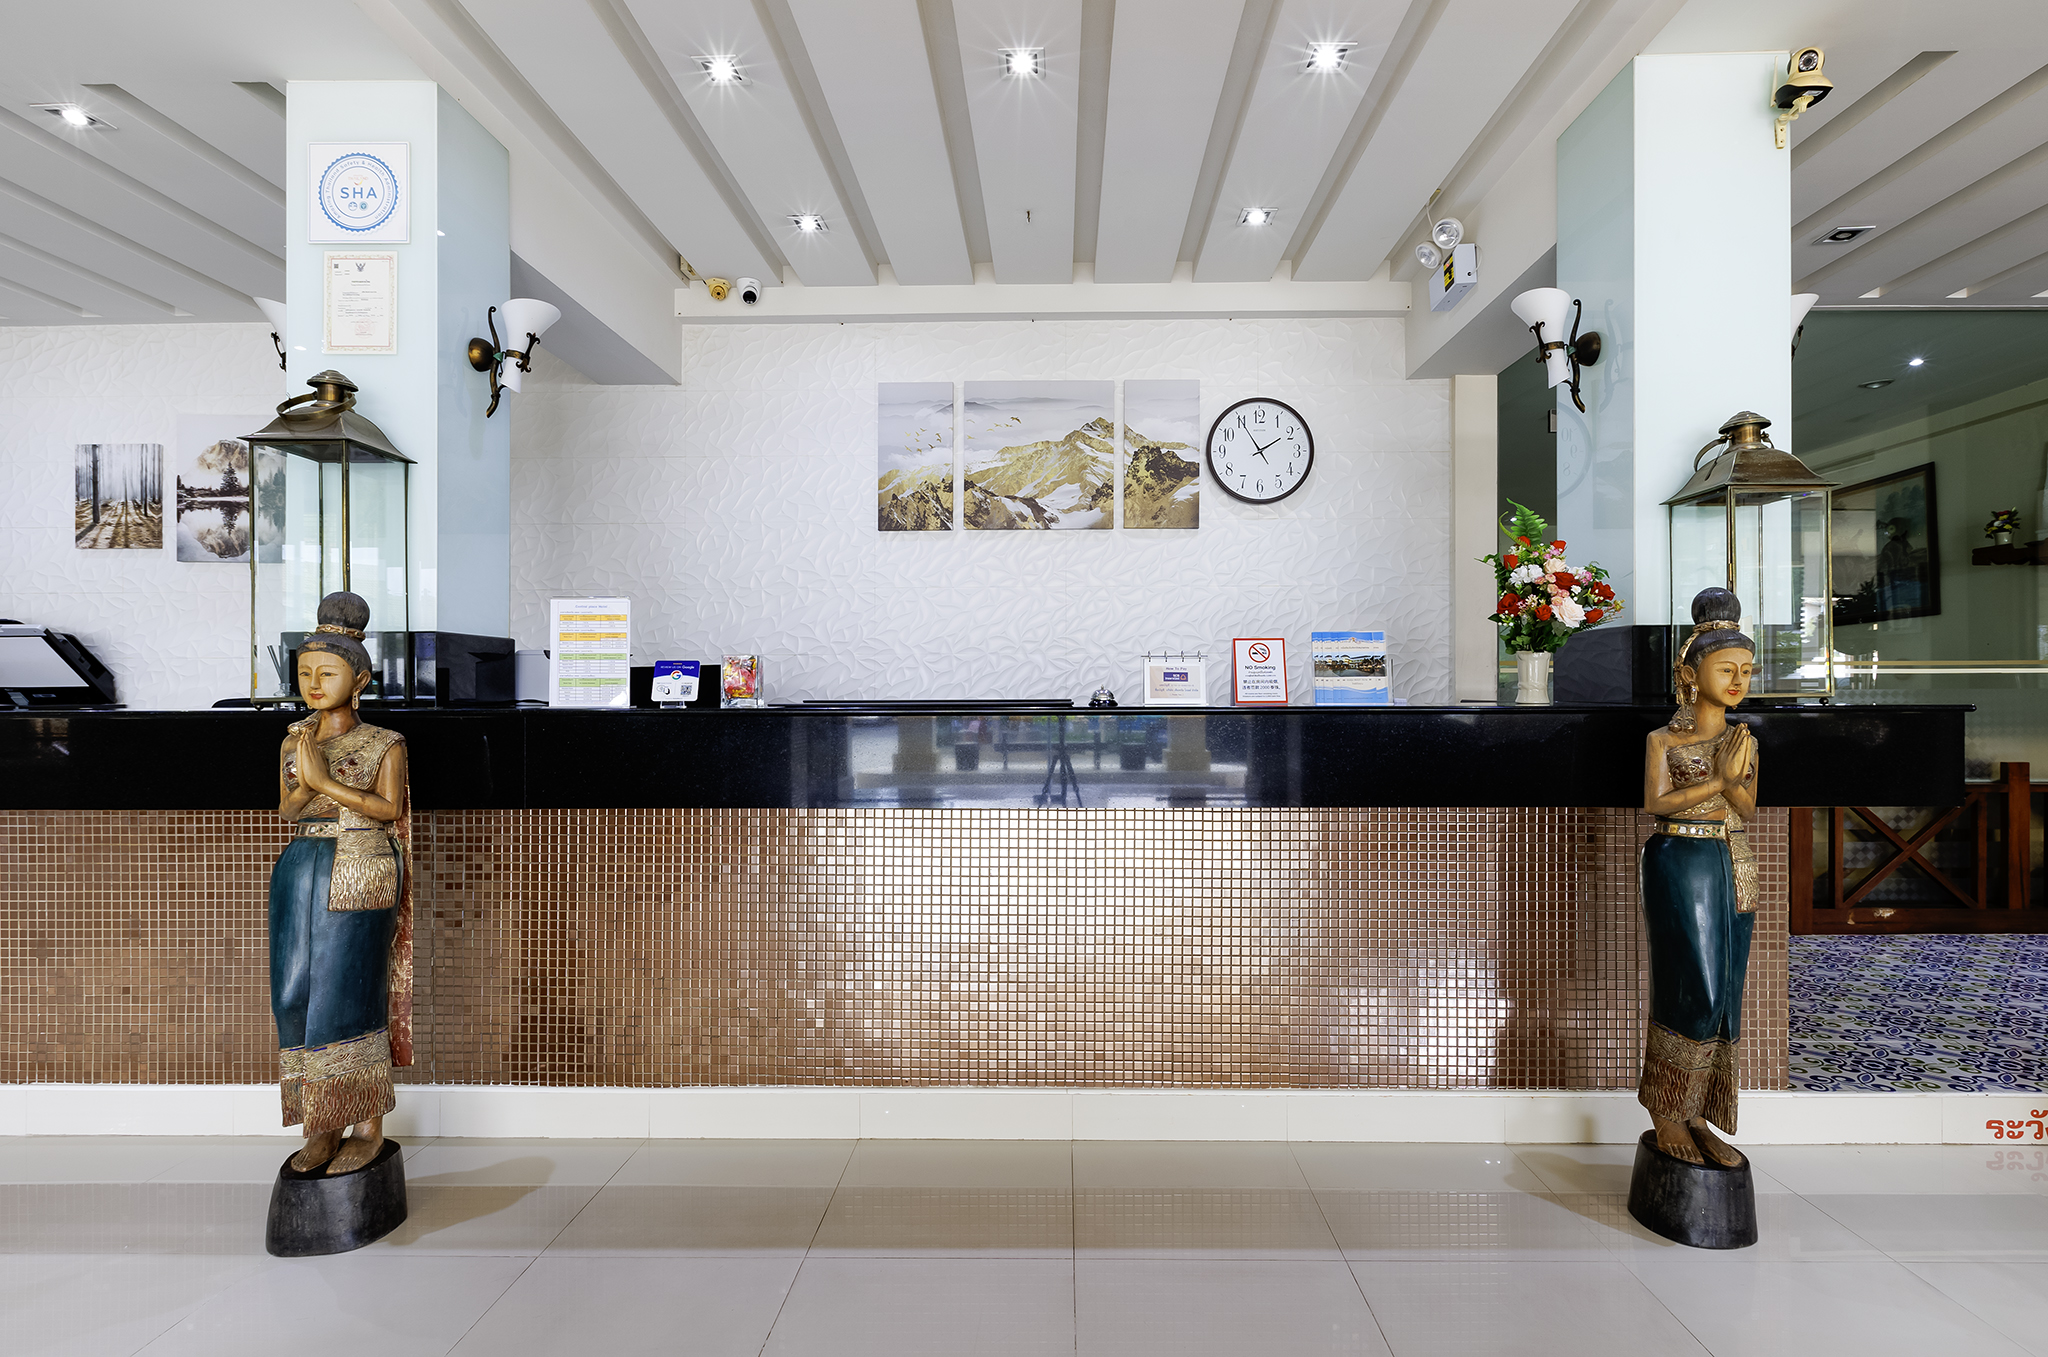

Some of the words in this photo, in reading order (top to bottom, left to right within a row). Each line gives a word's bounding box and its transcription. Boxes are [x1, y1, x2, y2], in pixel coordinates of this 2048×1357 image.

[326, 168, 341, 194] Thailand
[367, 162, 385, 177] Health
[340, 186, 378, 199] SHA
[1253, 409, 1266, 424] 12
[1274, 414, 1279, 428] 1
[1222, 427, 1235, 442] 10
[1285, 425, 1294, 440] 2
[1218, 443, 1226, 459] 9
[1293, 443, 1301, 458] 3
[1225, 461, 1233, 476] 8
[1286, 461, 1293, 476] 4
[1239, 474, 1246, 489] 7
[1256, 478, 1264, 493] 6
[1274, 474, 1282, 489] 5
[671, 670, 681, 680] G
[1986, 1109, 2048, 1140] ระวั
